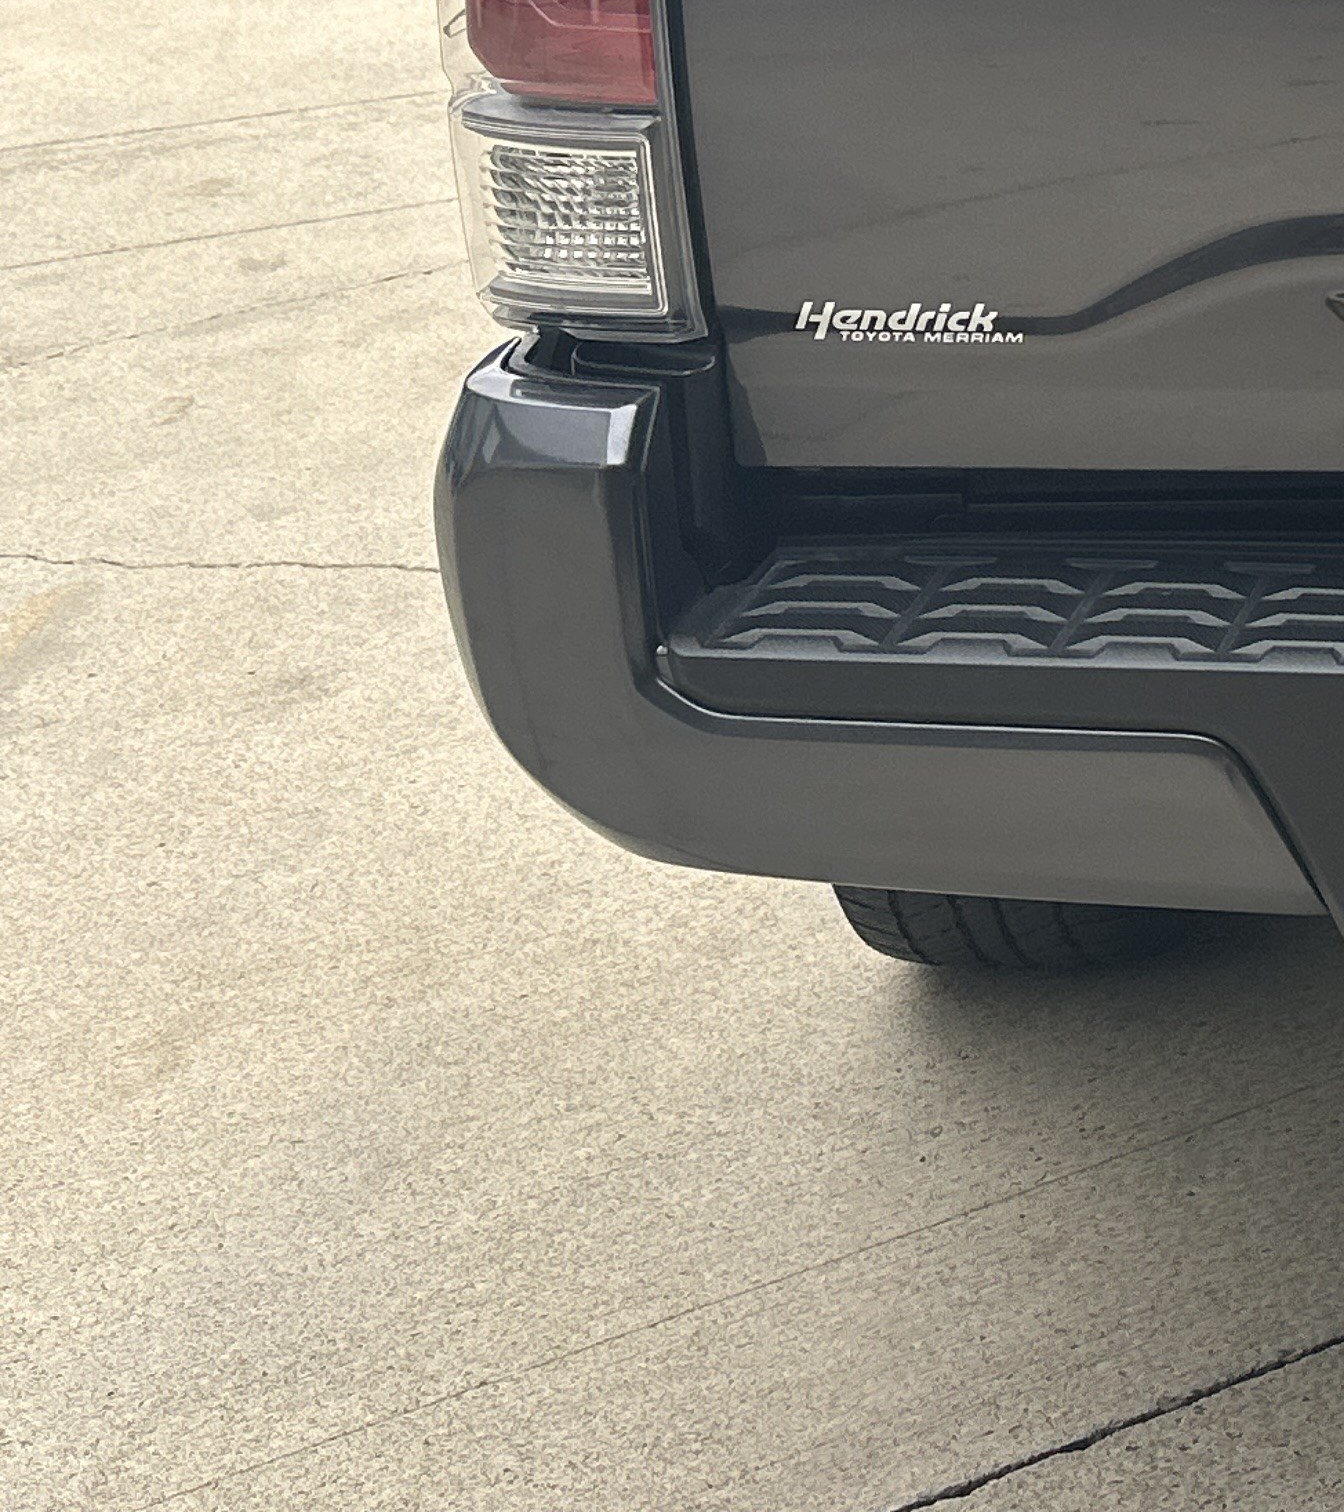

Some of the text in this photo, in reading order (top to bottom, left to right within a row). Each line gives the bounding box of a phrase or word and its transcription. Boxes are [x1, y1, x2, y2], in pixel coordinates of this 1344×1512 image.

[794, 301, 999, 340] Hendrick
[839, 330, 1025, 343] TOYOTA MERRIAM
